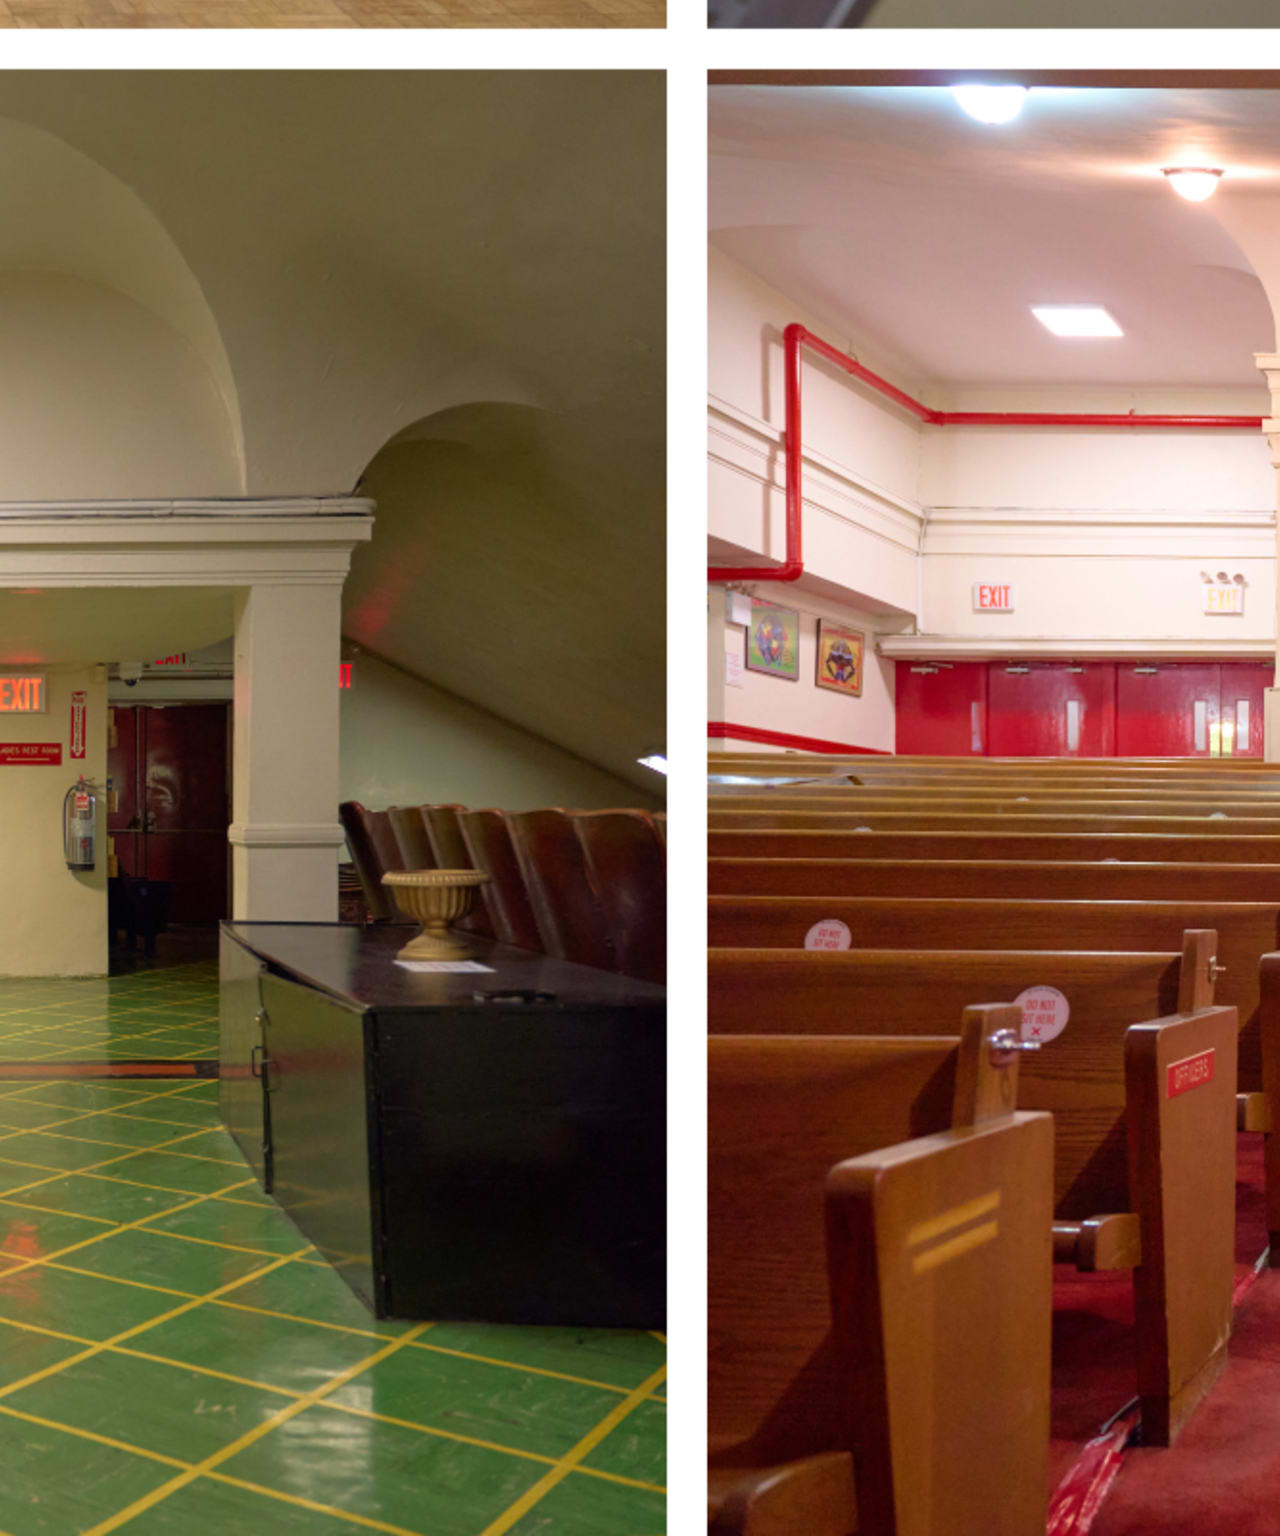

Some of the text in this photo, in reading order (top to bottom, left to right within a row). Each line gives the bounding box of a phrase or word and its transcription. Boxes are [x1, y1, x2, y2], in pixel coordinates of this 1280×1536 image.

[979, 585, 1011, 608] EXIT
[1207, 588, 1239, 611] EXIT
[1026, 999, 1056, 1011] DO NOT
